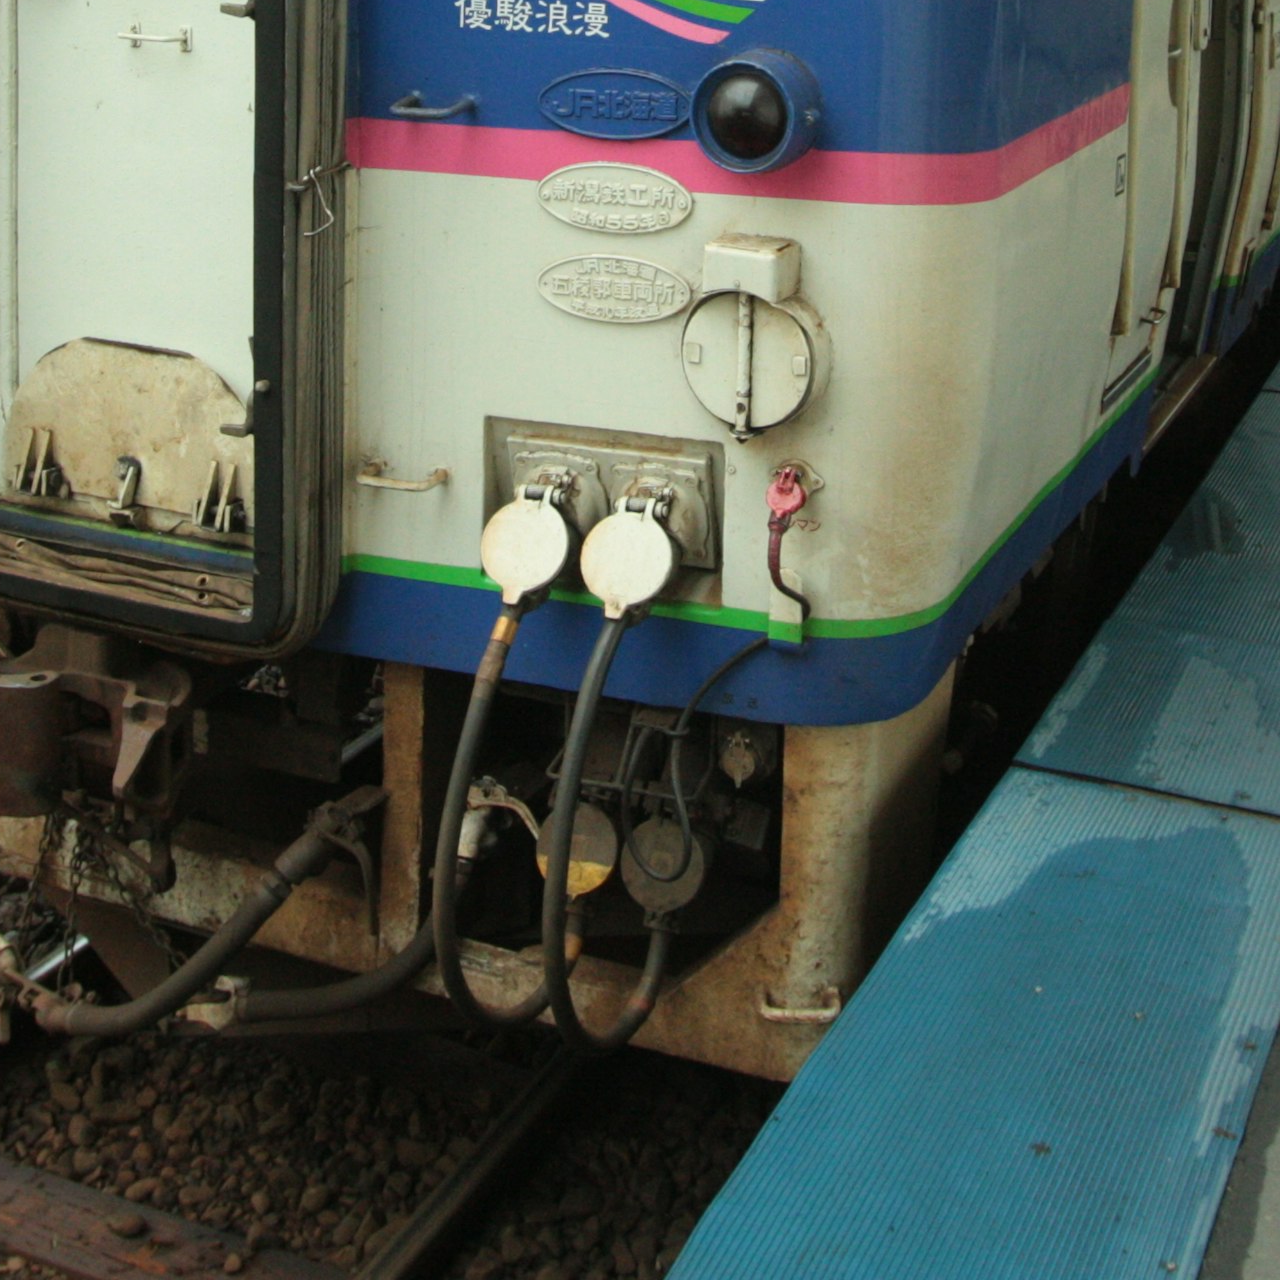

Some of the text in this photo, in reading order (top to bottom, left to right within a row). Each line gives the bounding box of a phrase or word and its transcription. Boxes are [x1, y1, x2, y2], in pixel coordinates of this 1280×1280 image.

[551, 87, 680, 122] JR北海道
[551, 177, 677, 210] 新潟鉄工所
